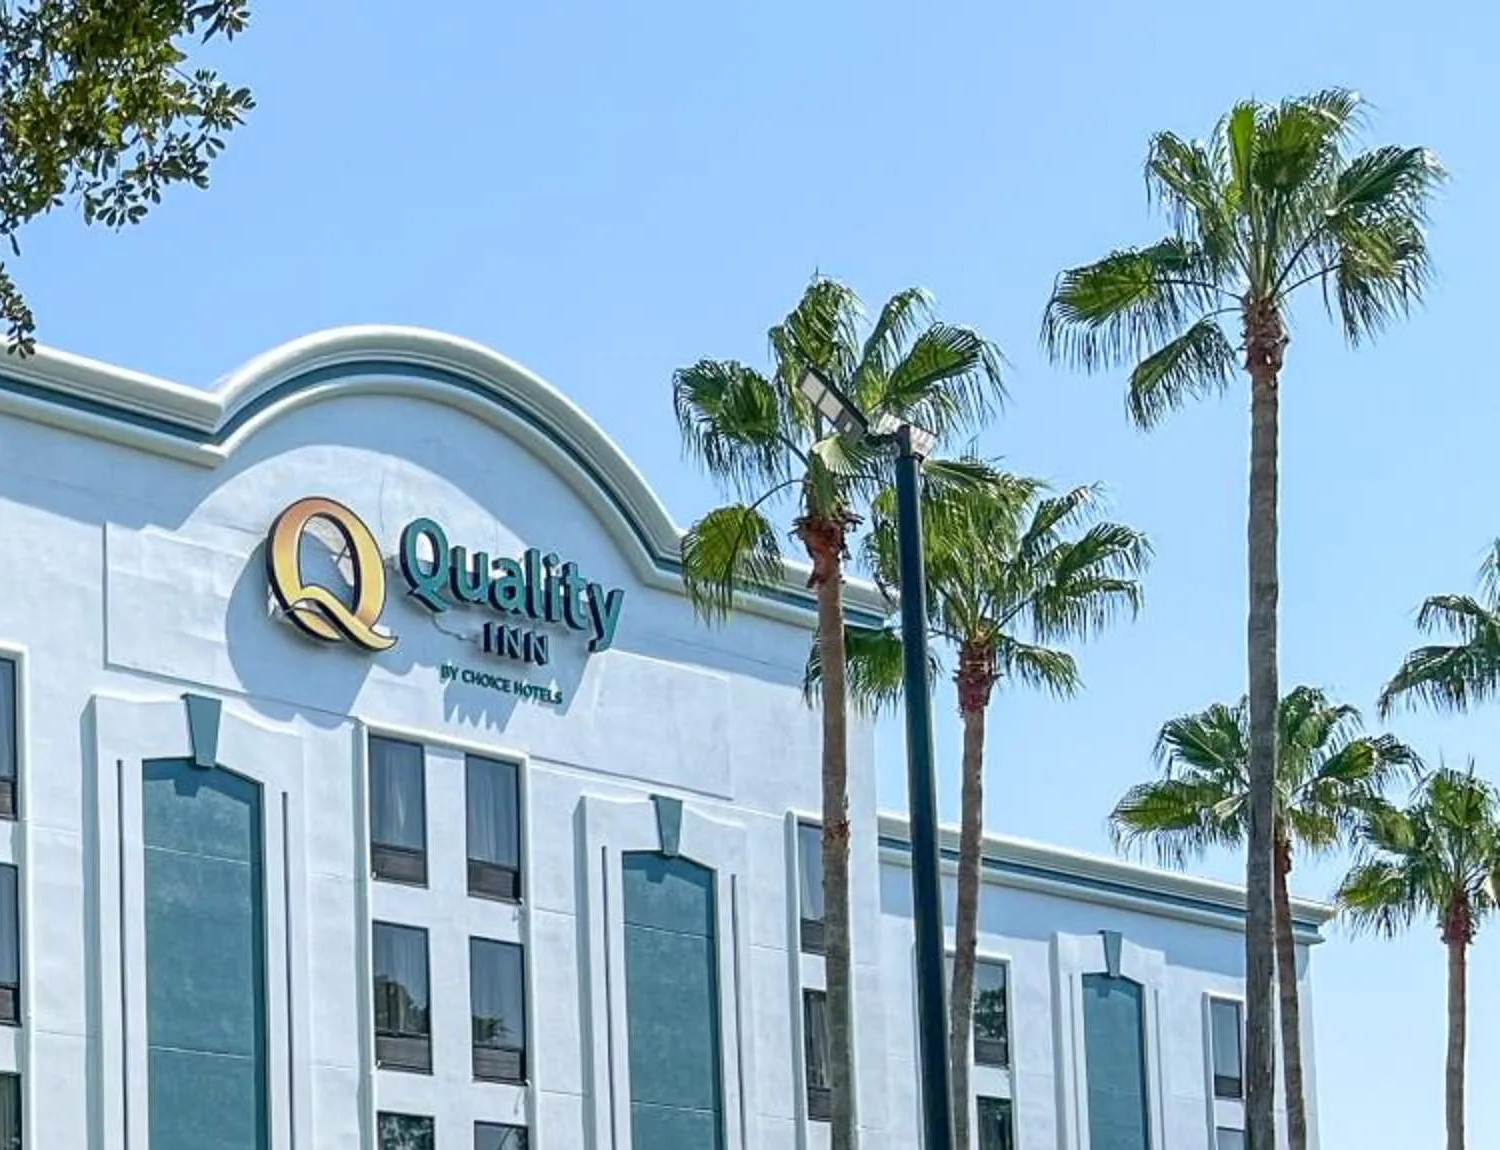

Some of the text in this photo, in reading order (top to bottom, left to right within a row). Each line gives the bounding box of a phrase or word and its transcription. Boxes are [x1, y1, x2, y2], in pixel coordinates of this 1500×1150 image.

[266, 496, 398, 651] Q
[400, 518, 625, 652] Quality
[441, 664, 563, 705] BY CHOICE HOTELS
[483, 621, 549, 666] INN
